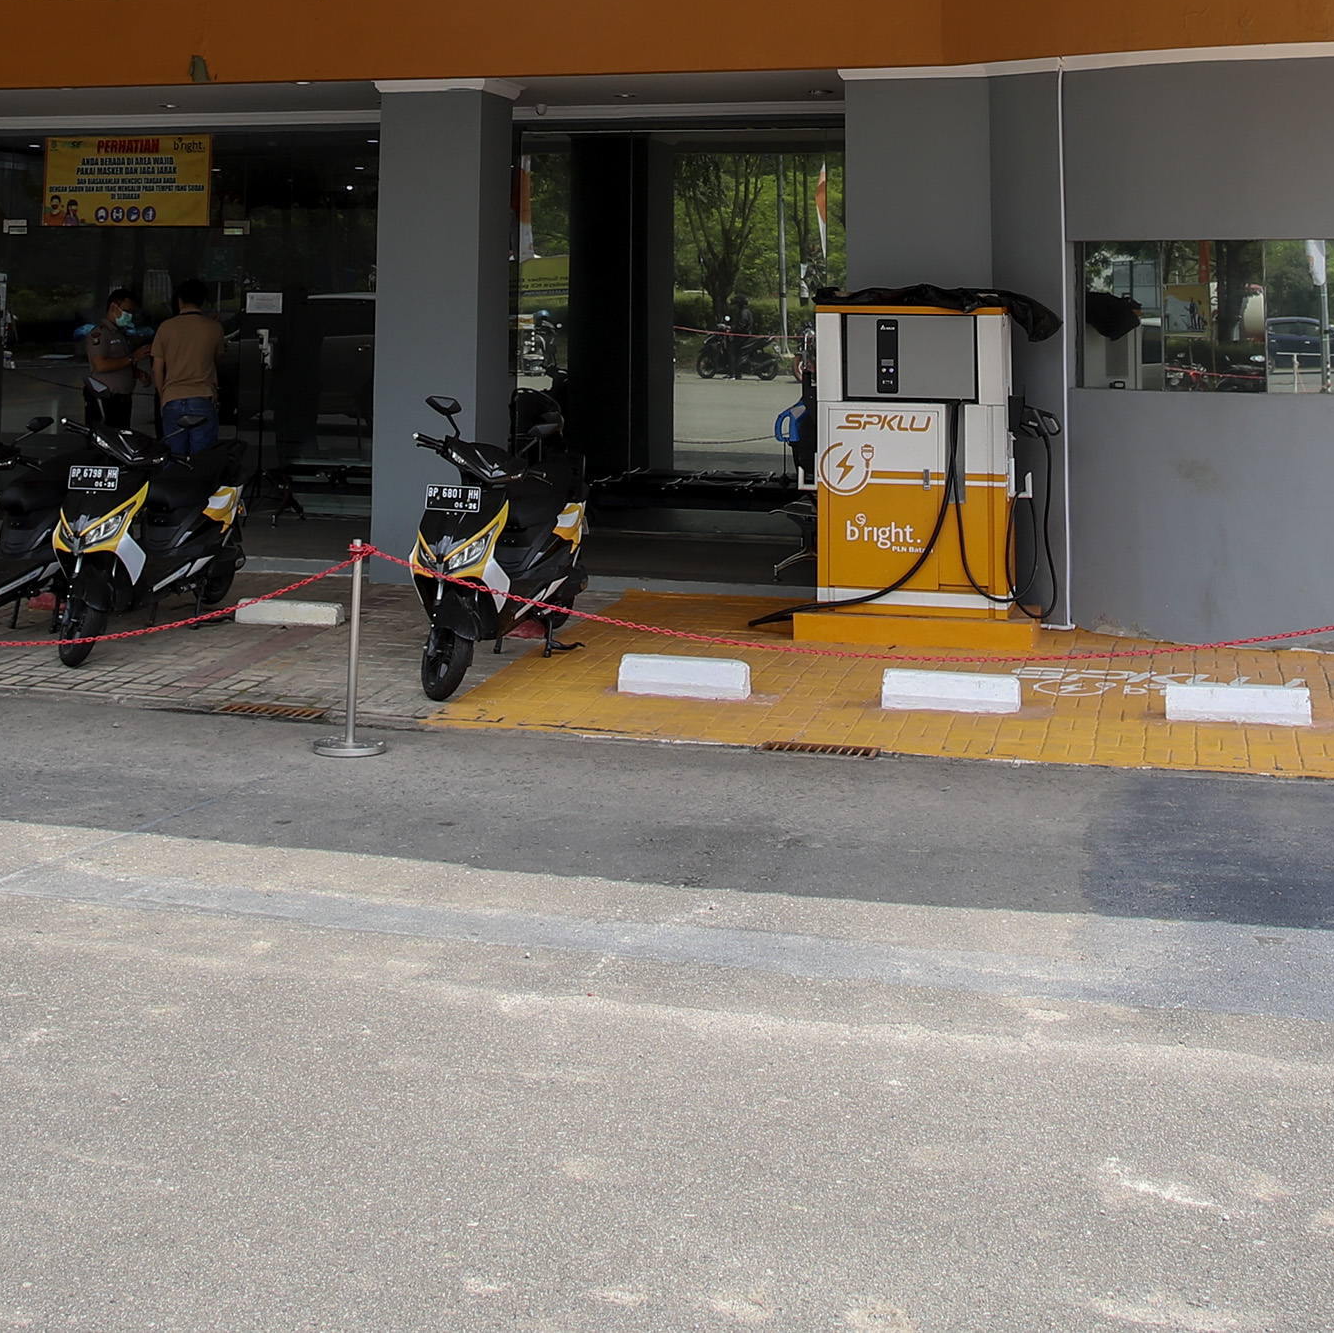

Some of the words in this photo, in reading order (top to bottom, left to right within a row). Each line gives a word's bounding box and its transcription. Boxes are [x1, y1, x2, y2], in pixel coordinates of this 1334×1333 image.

[97, 138, 159, 154] PERHATIAN
[81, 157, 99, 166] ANDA
[100, 157, 125, 166] BERADA
[126, 157, 134, 166] DI
[135, 156, 152, 166] AREA
[153, 156, 174, 165] WAJIB
[76, 167, 96, 175] PAKAI
[97, 167, 124, 175] MASKER
[124, 166, 138, 175] DAN
[139, 166, 156, 174] JAGA
[157, 166, 177, 174] JARAK
[835, 413, 932, 433] SPKLU
[72, 468, 82, 478] BP
[83, 468, 103, 479] 6798
[428, 486, 439, 497] BP
[442, 487, 462, 499] 6801
[467, 489, 479, 500] HH
[892, 545, 908, 553] PLN
